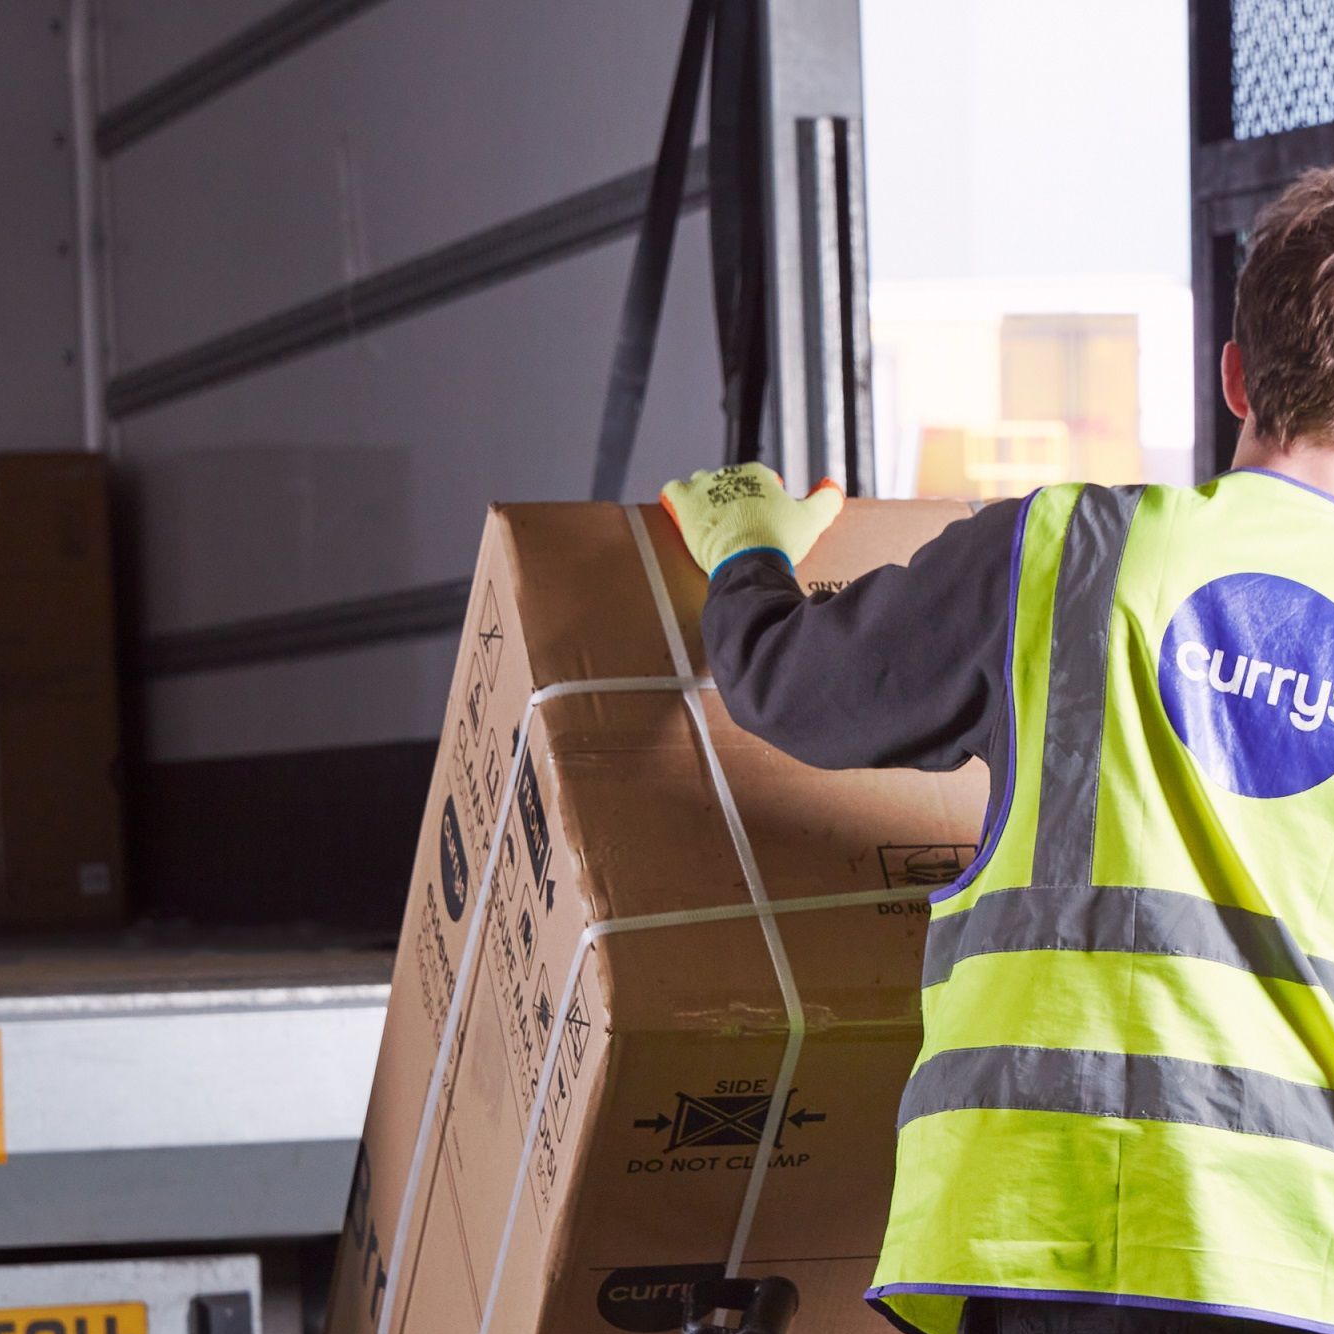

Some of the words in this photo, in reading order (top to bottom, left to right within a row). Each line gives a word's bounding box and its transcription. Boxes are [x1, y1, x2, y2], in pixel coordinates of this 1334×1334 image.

[522, 773, 545, 861] FRONT
[445, 814, 465, 903] currys
[458, 719, 485, 826] CLAMP
[482, 829, 517, 984] PESSURE
[878, 903, 903, 915] DO
[909, 903, 931, 914] NO
[715, 1079, 767, 1094] SIDE
[627, 1159, 663, 1173] DO
[670, 1157, 721, 1171] NOT
[726, 1153, 810, 1170] CLMP
